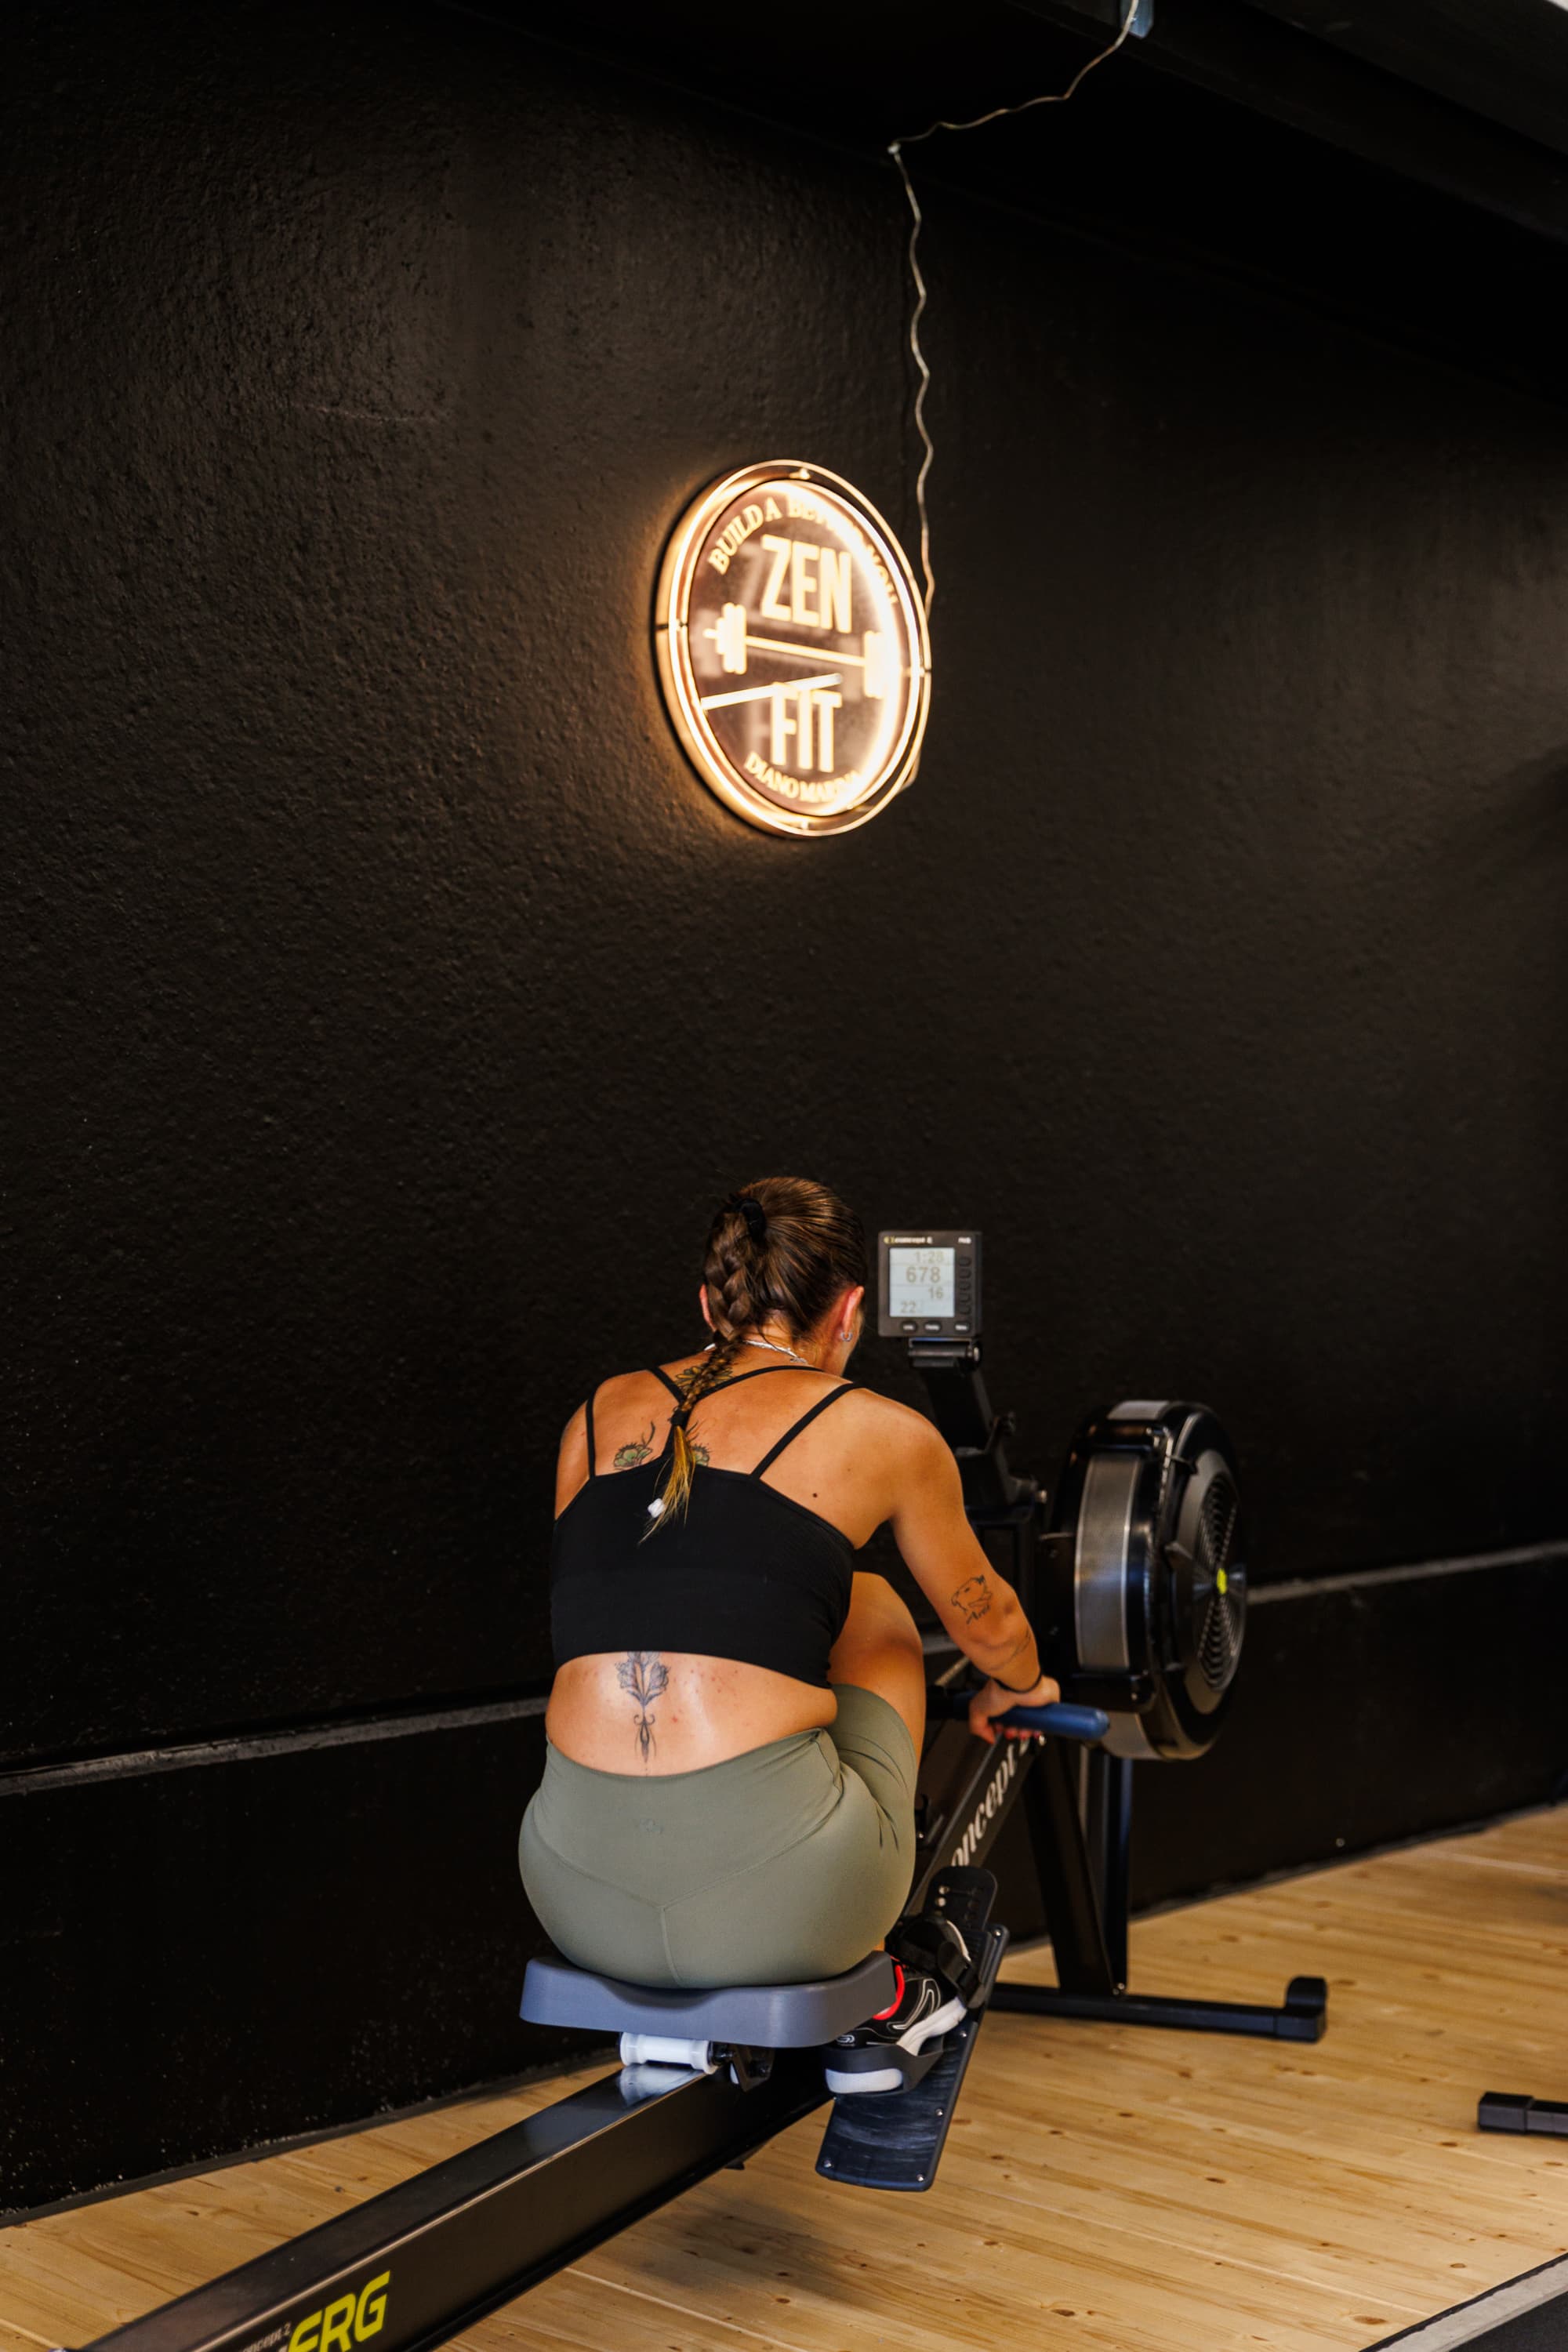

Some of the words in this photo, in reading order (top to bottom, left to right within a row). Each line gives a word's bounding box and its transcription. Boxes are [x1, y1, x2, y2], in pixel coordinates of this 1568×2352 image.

[708, 504, 764, 575] BUILD
[760, 534, 852, 633] ZEN
[770, 682, 842, 773] FIT
[744, 752, 800, 799] DIANO
[906, 1266, 941, 1283] 678
[287, 2270, 390, 2352] ERG
